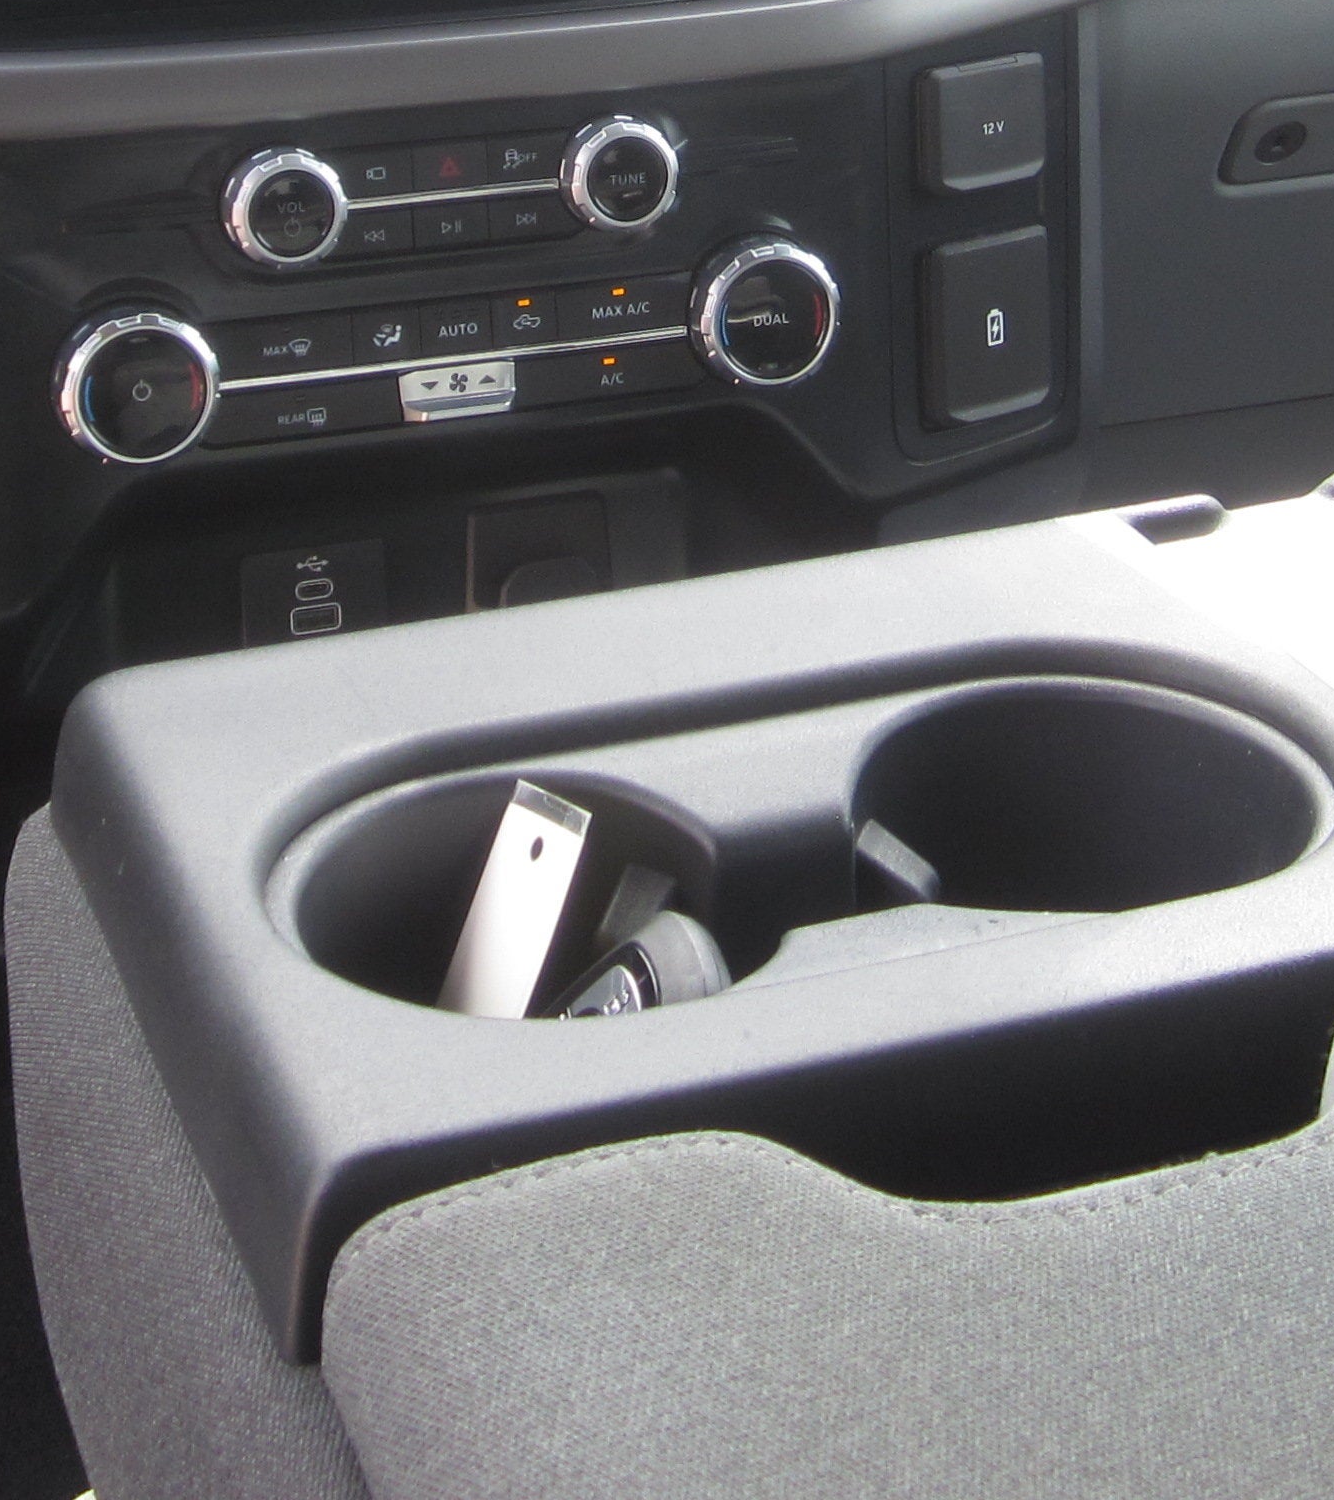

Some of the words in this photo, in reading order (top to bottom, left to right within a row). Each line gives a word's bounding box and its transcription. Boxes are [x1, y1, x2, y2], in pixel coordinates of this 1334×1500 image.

[982, 121, 995, 136] 12
[996, 120, 1005, 132] V
[609, 171, 647, 186] TUNE
[276, 200, 306, 215] VOL
[591, 304, 624, 320] MAX
[625, 301, 651, 316] A/C
[753, 312, 790, 328] DUAL
[437, 322, 479, 339] AUTO
[263, 344, 289, 358] MAX
[600, 372, 625, 387] A/C
[277, 411, 306, 426] REAR
